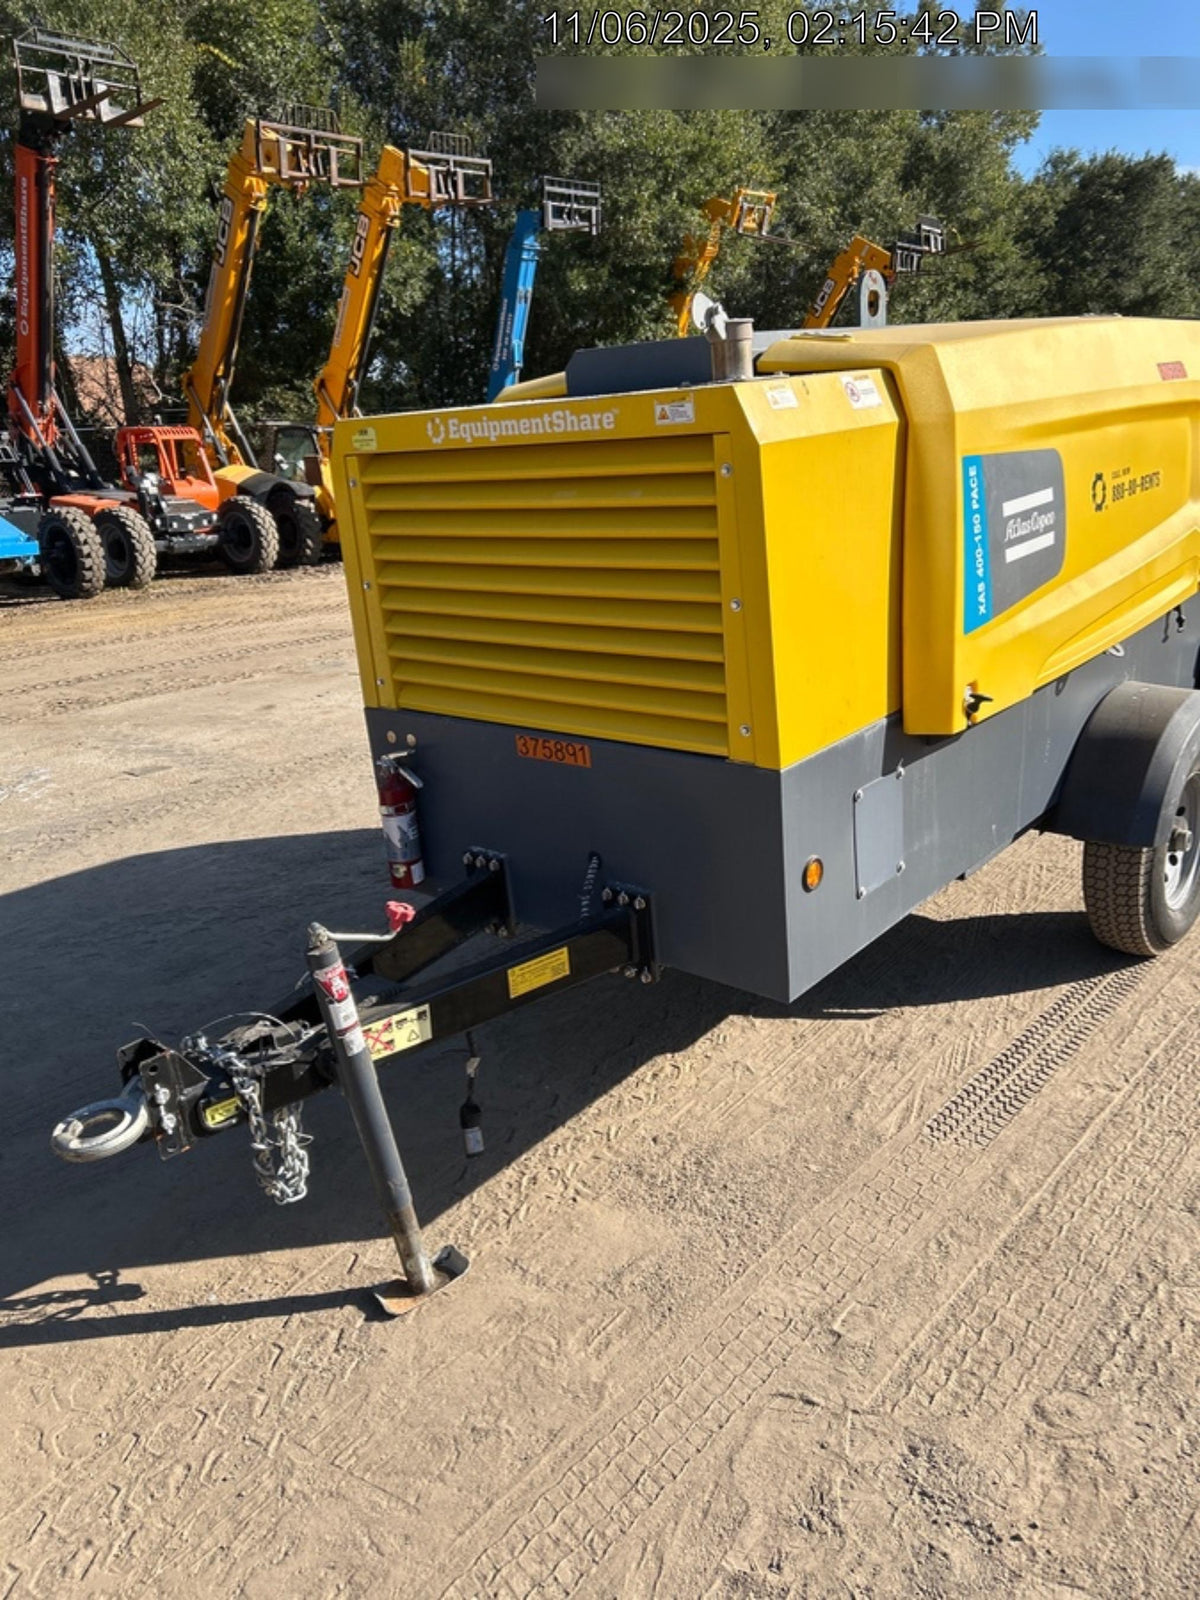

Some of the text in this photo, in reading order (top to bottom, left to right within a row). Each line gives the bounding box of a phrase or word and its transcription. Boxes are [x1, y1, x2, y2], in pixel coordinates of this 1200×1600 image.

[216, 198, 233, 266] JCB
[351, 214, 370, 277] JCB
[813, 279, 835, 317] JCB
[448, 410, 616, 443] EquipmentShare
[968, 465, 987, 615] XAS 400-150 PACE
[519, 735, 588, 765] 375891
